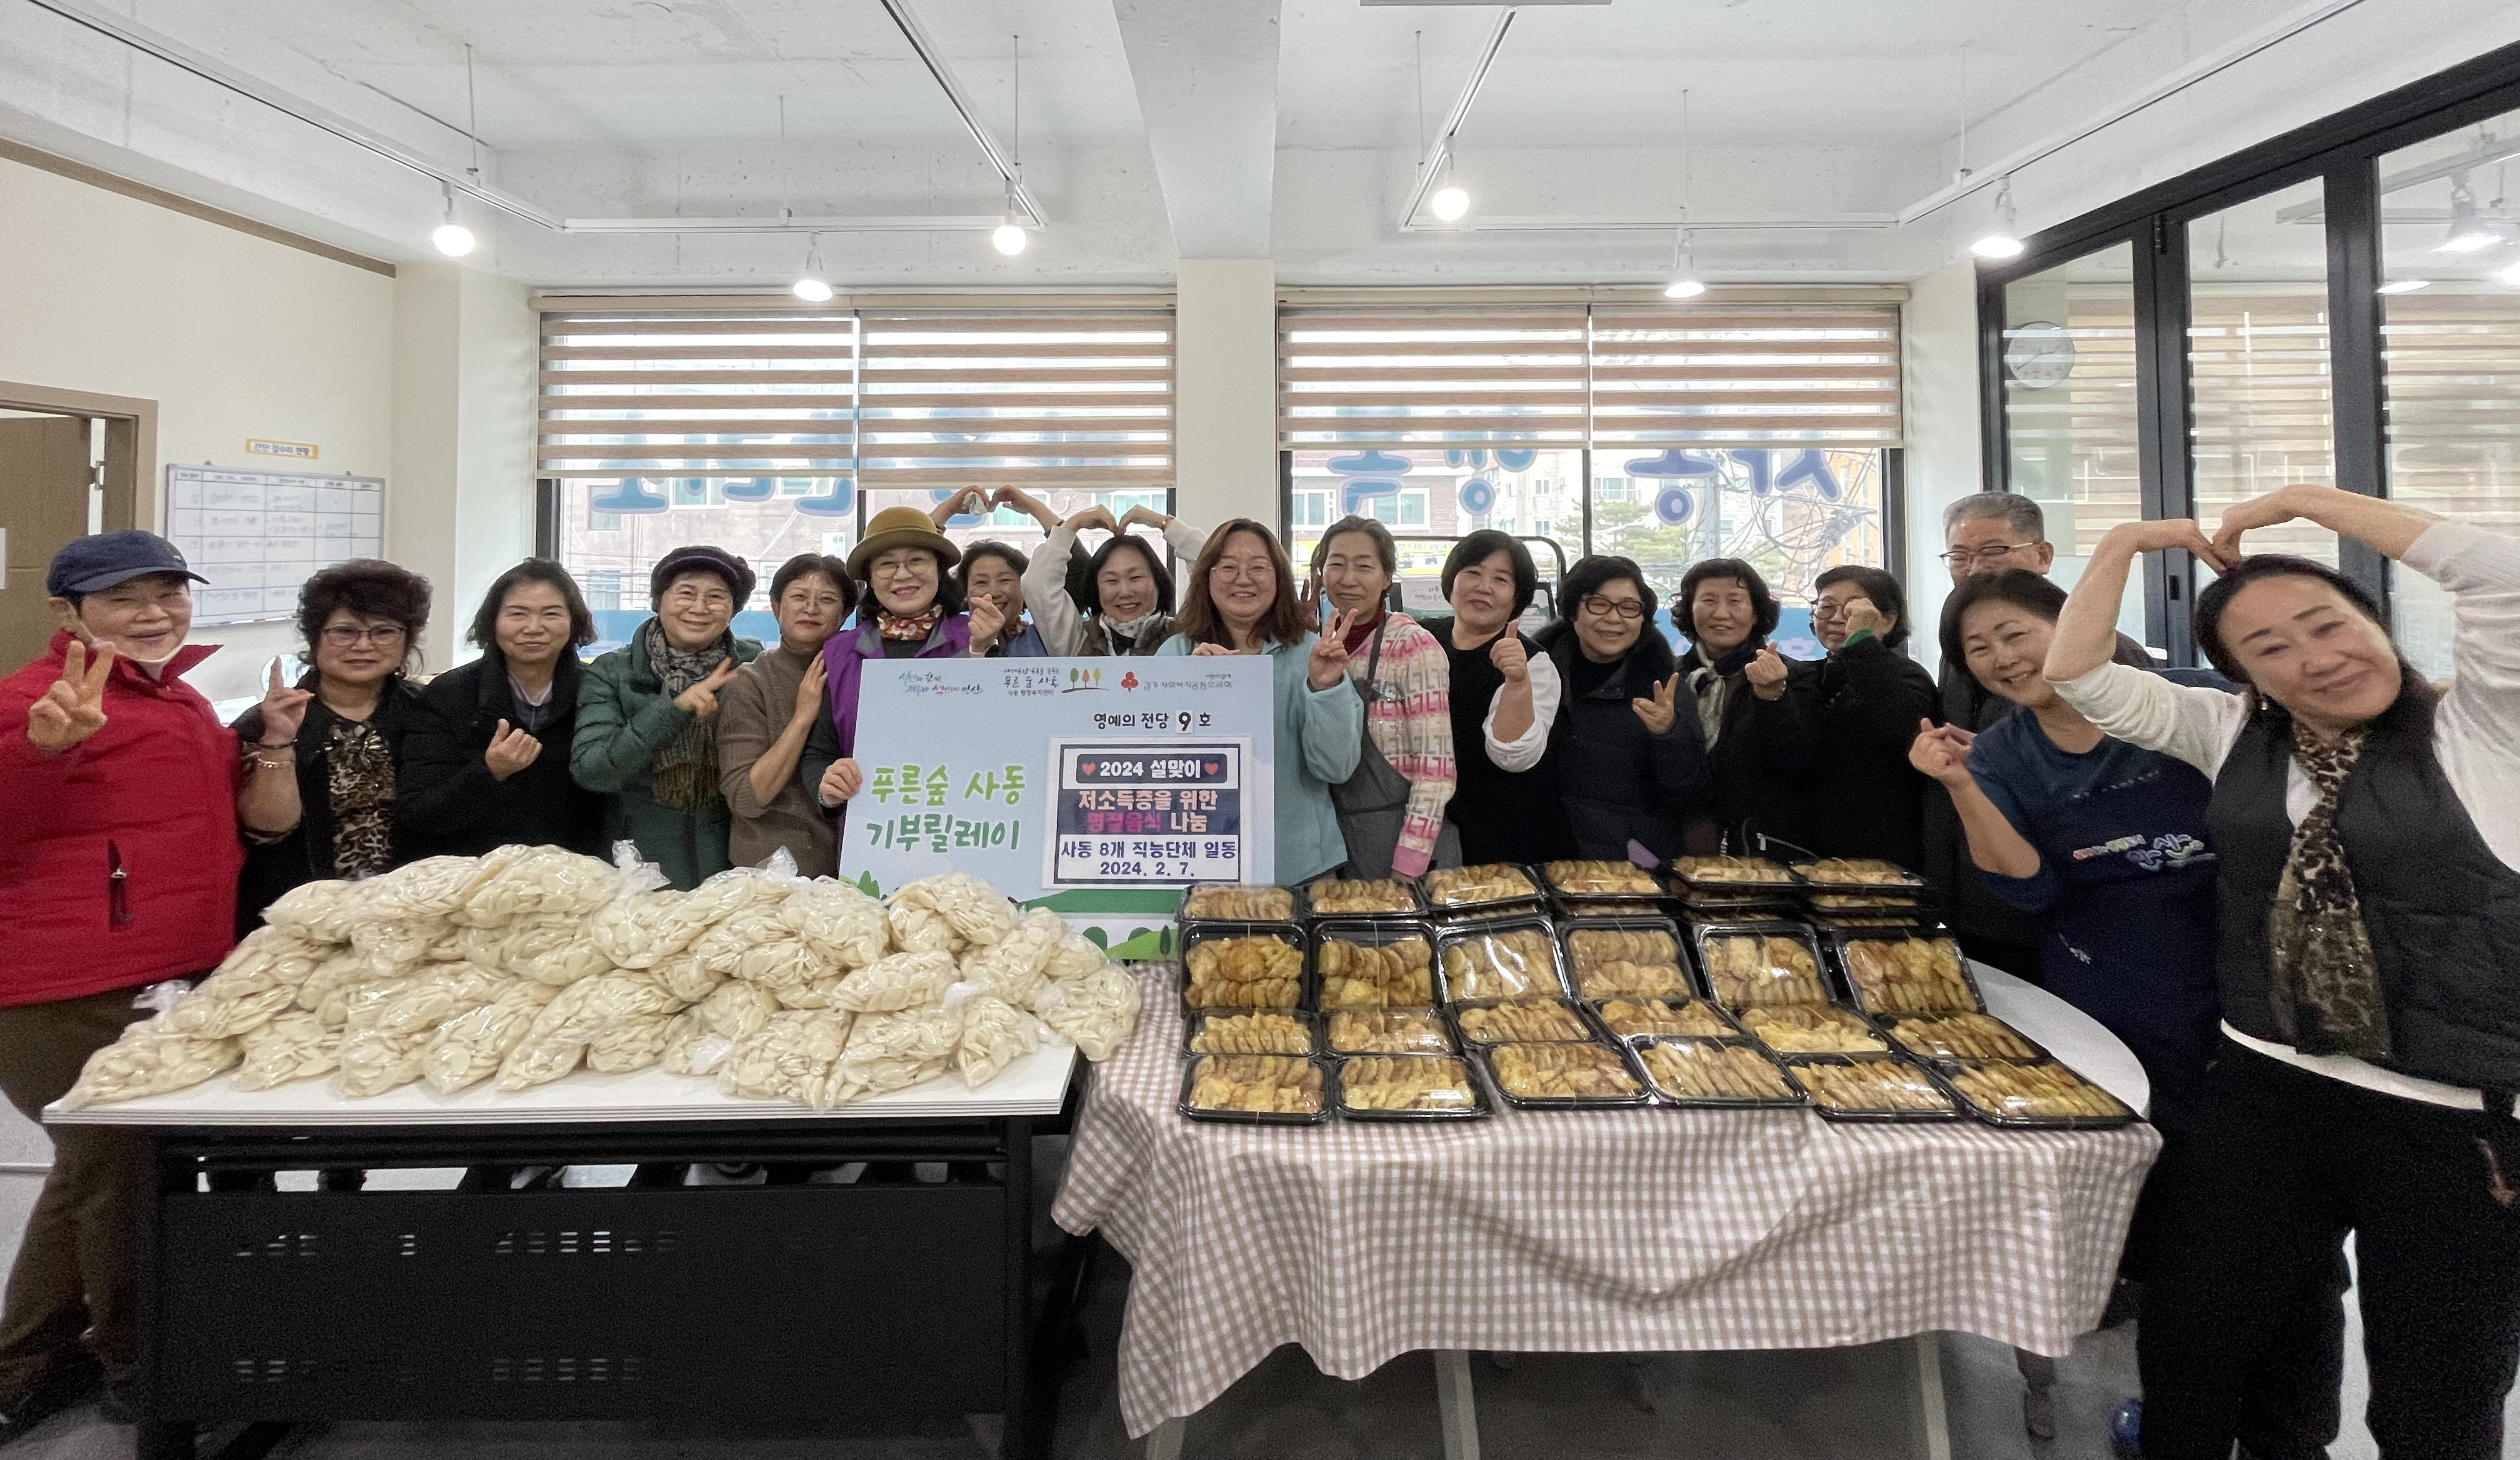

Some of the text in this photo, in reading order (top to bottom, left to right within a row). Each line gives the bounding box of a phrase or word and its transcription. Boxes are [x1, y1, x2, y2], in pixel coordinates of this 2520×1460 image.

[1004, 676, 1020, 688] 푸른
[1038, 676, 1060, 688] 사동
[1094, 712, 1211, 731] 영예의 전당 9 호
[1099, 759, 1201, 779] 2024 설맞이
[871, 764, 1026, 806] 푸른숲 사동
[1079, 790, 1218, 811] 저소득층을 위한
[1088, 812, 1208, 833] 명절음식 나눔
[866, 813, 1020, 853] 기부릴레이
[1061, 841, 1236, 859] 사동 8개 직능단체 일동
[1100, 861, 1195, 877] 2024. 2. 7.
